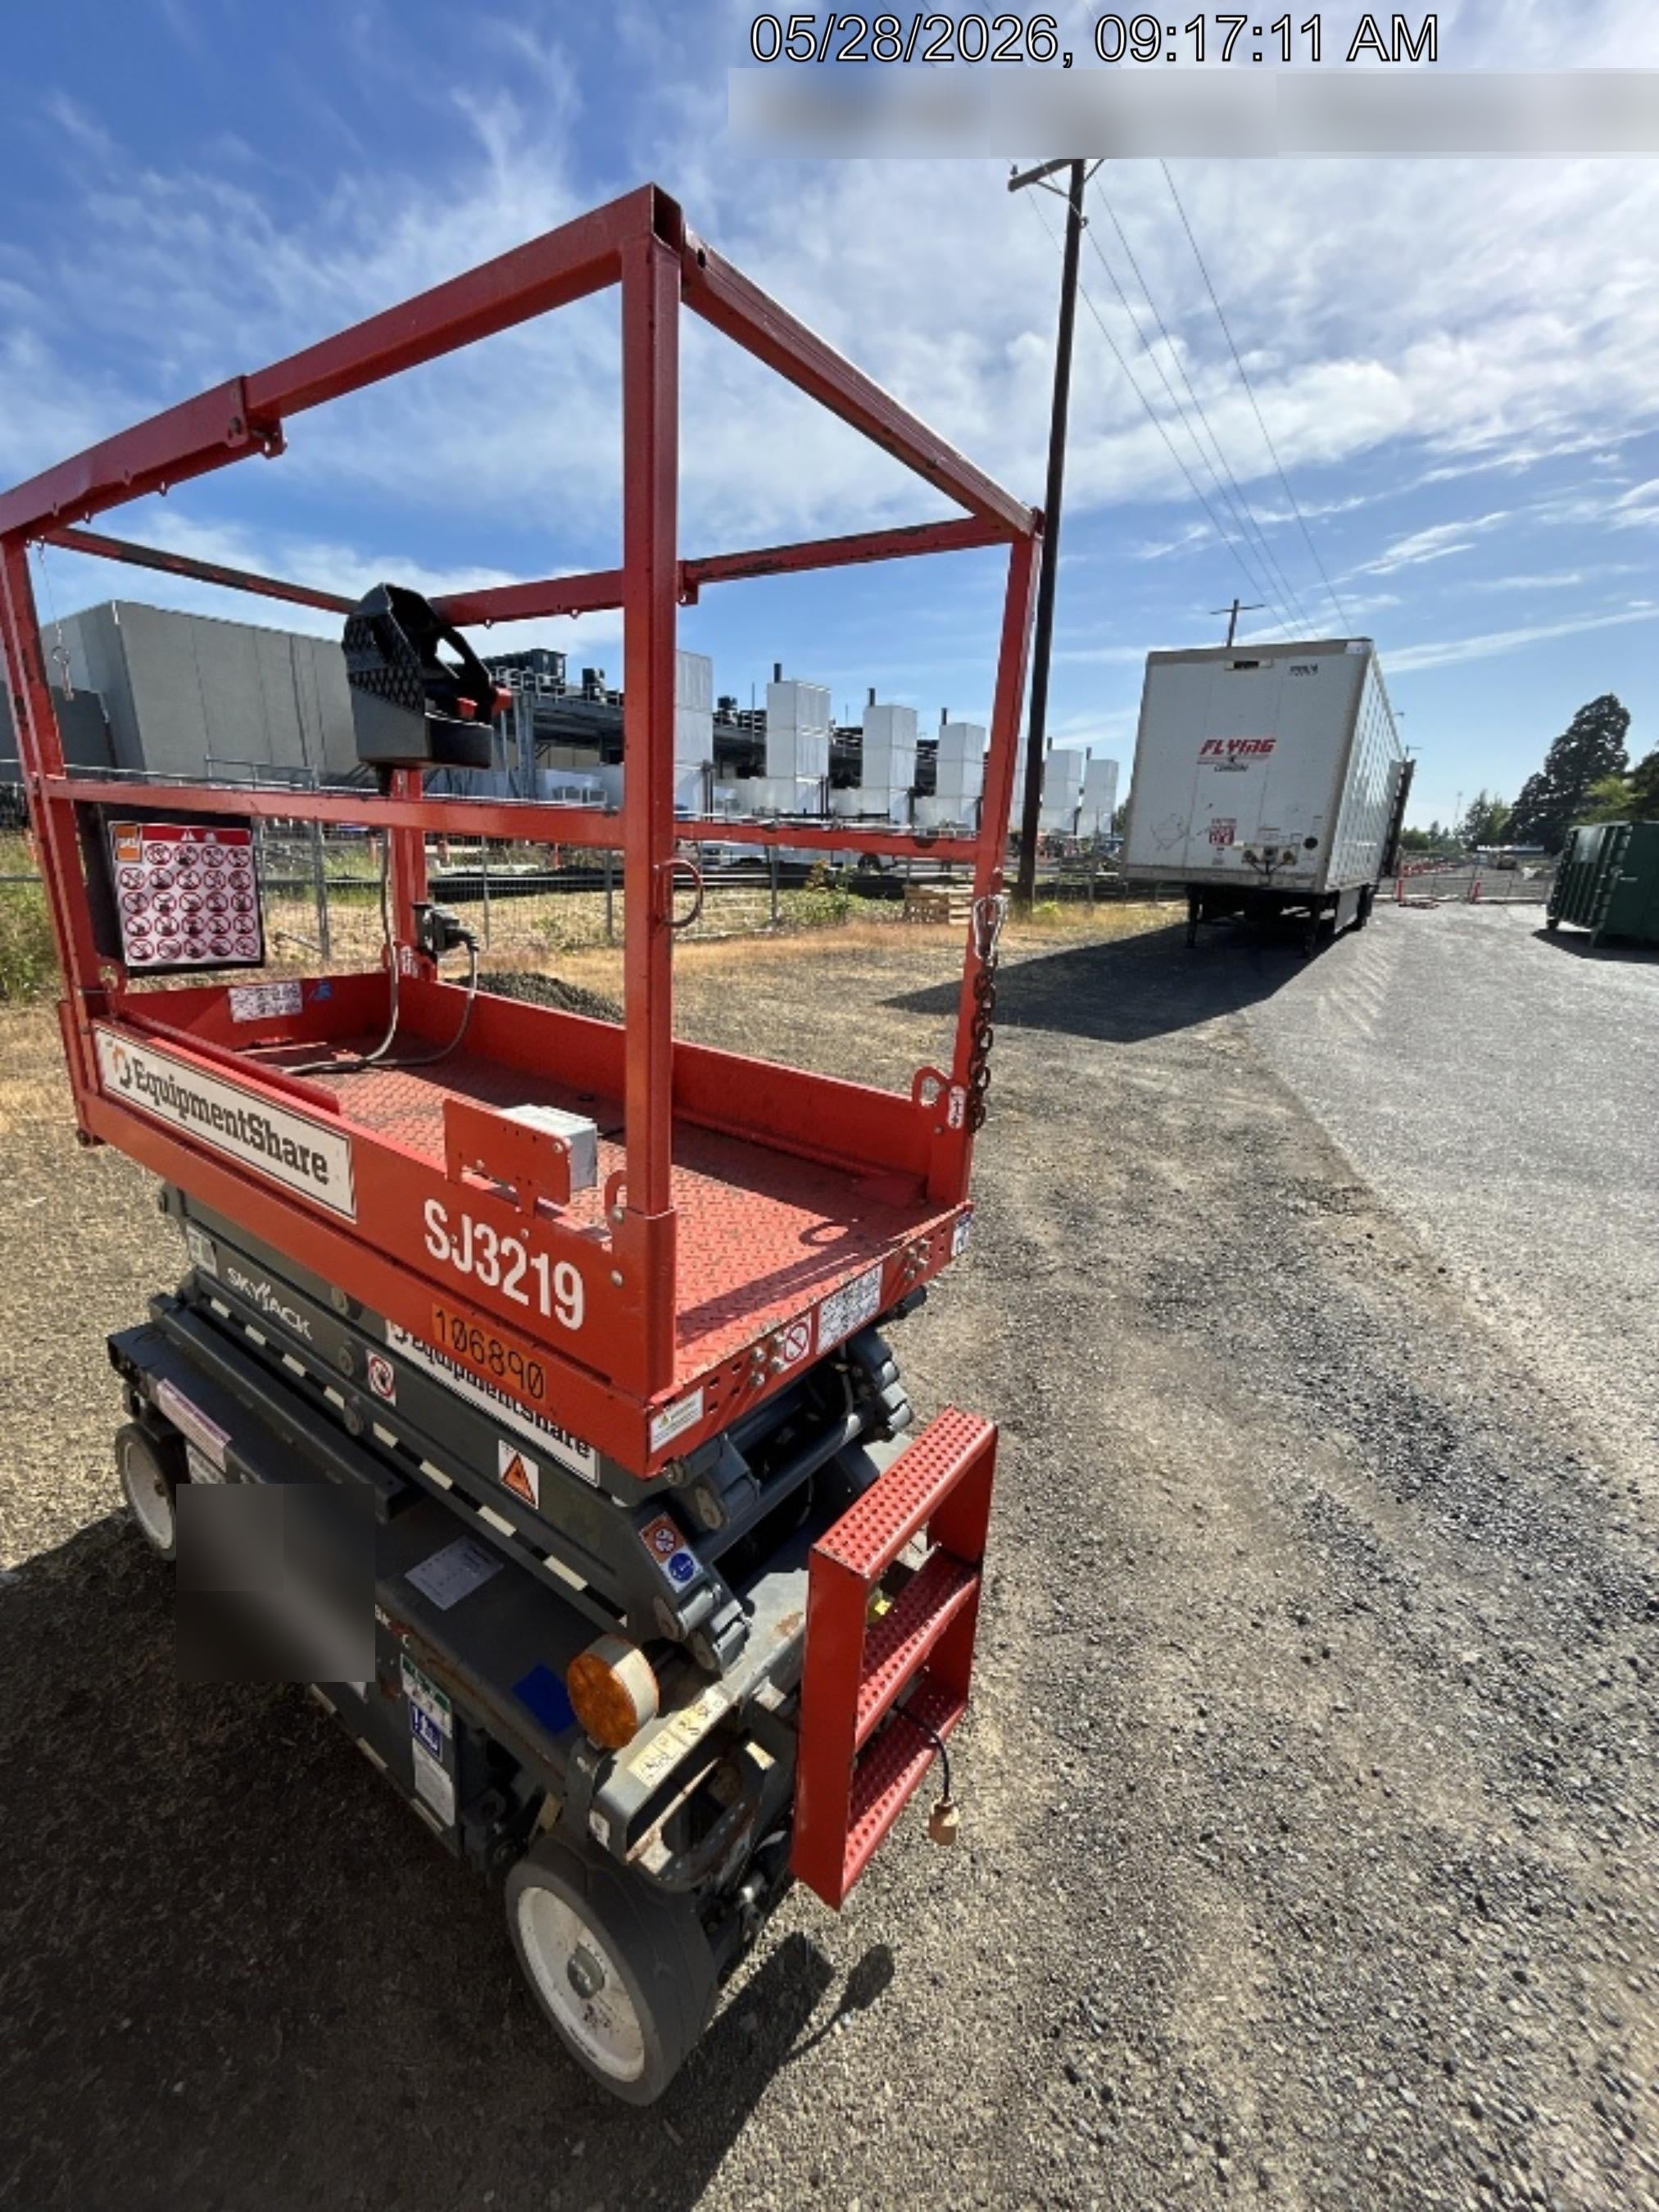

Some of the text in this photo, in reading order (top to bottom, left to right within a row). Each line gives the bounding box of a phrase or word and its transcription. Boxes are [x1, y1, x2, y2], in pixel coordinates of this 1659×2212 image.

[1199, 739, 1276, 755] FLYING
[132, 1058, 330, 1185] EquipmentShare
[227, 1267, 314, 1341] SKYJACK
[424, 1199, 585, 1330] SJ3219
[435, 1309, 544, 1399] 106890
